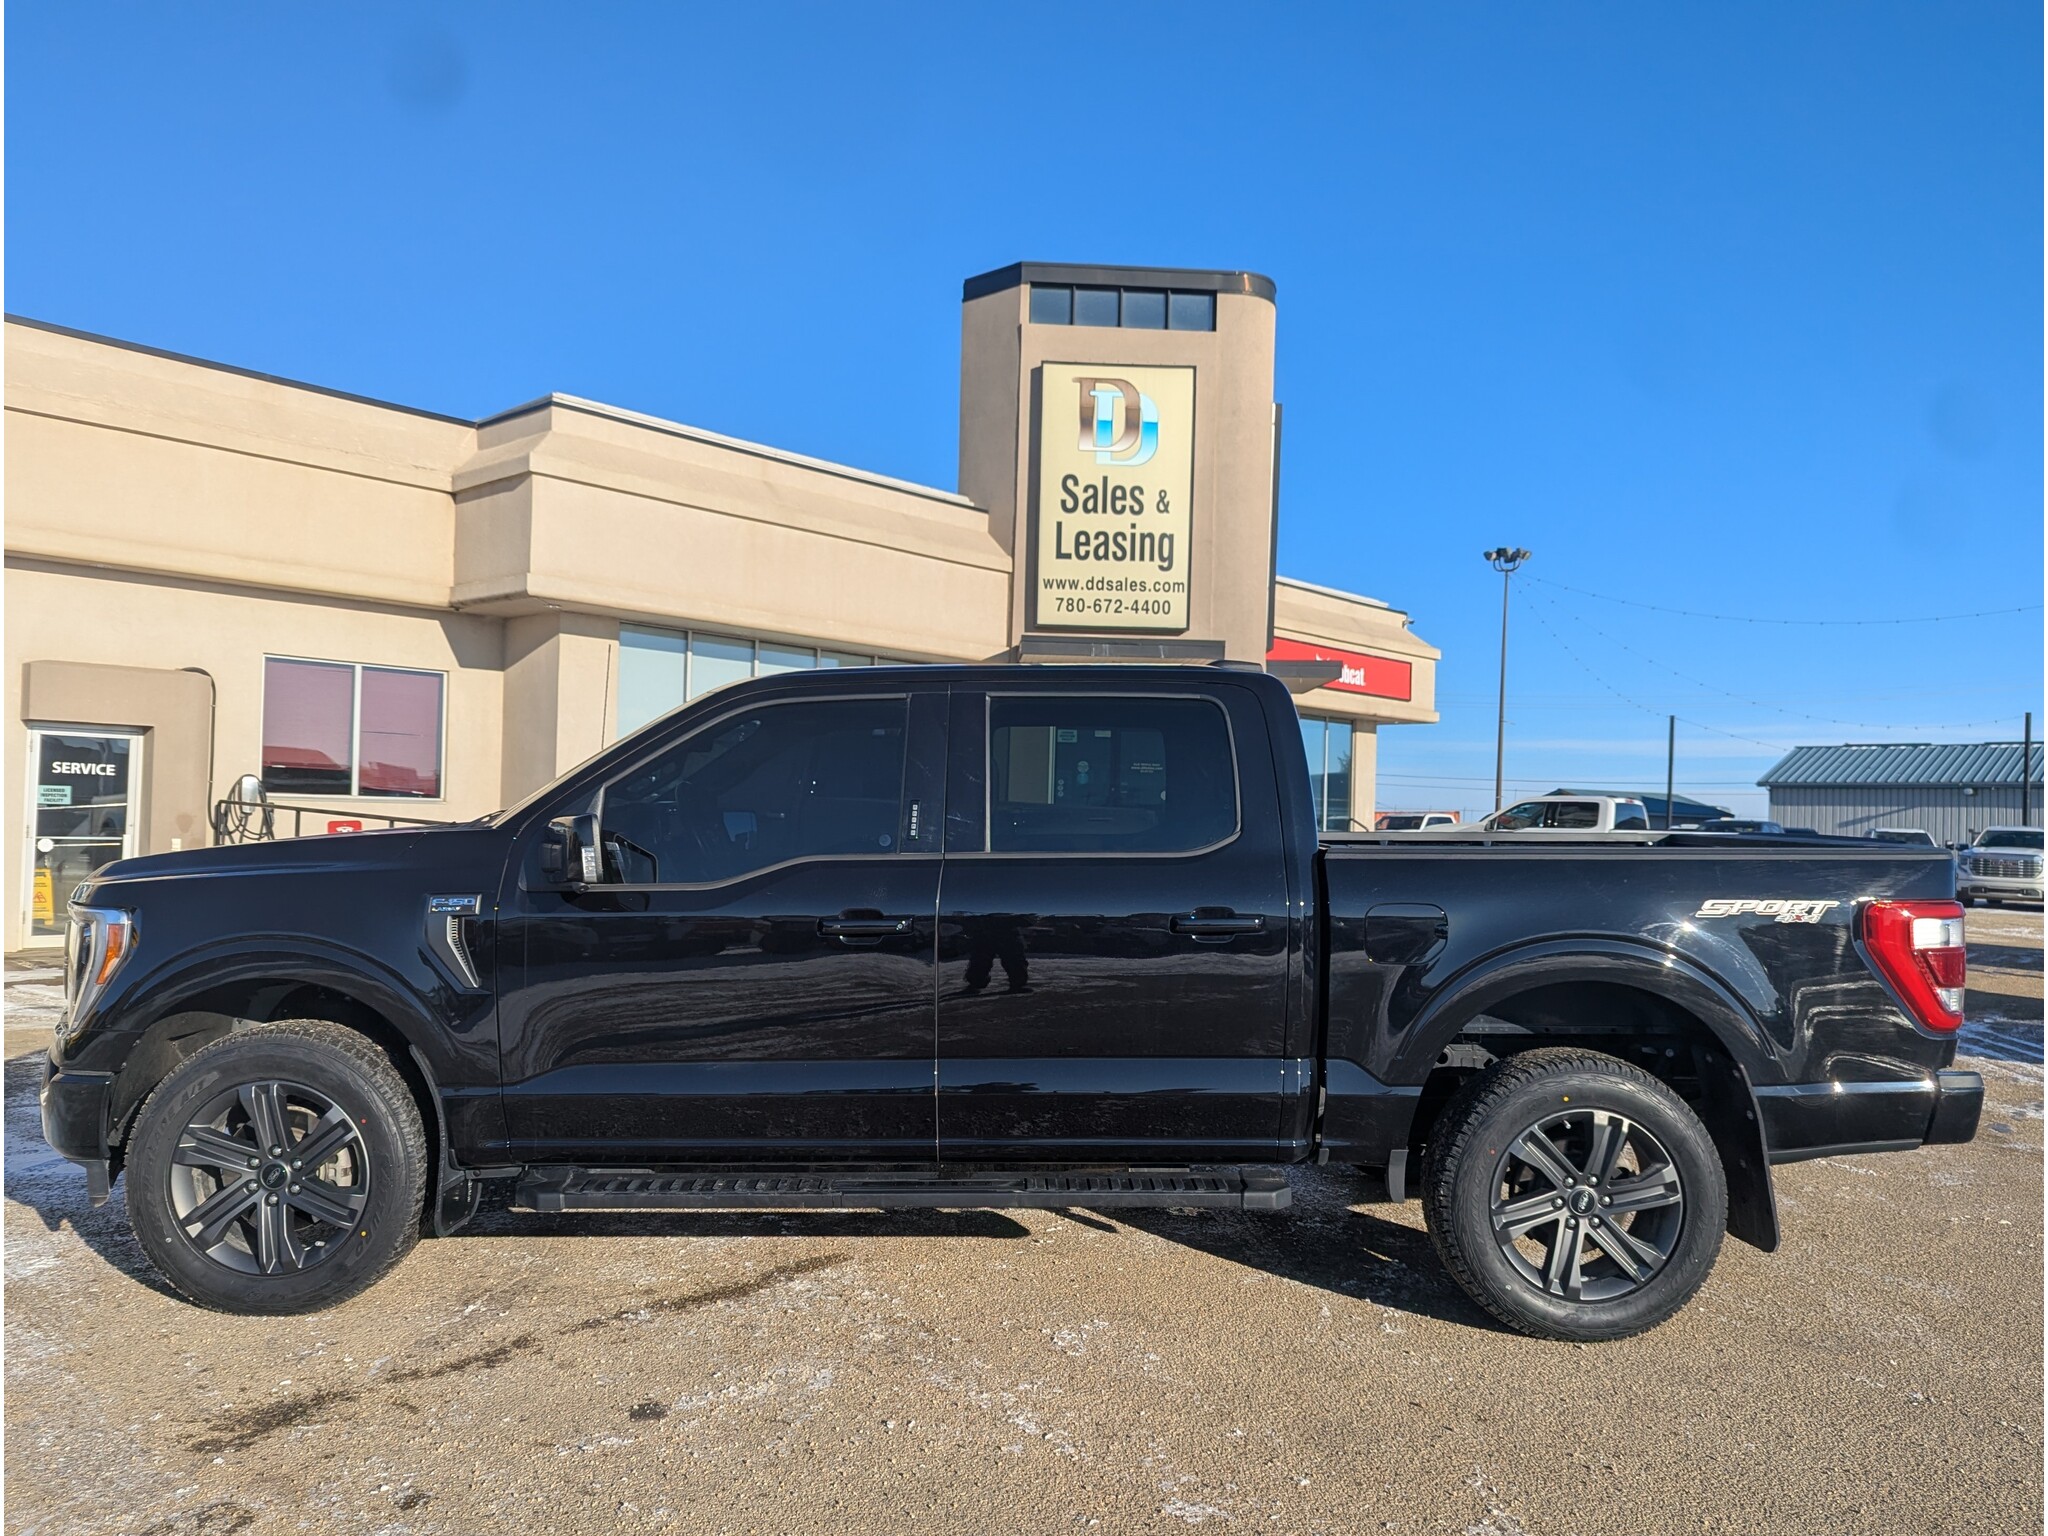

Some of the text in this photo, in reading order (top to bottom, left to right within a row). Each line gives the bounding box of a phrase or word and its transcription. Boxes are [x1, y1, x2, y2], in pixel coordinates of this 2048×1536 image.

[1060, 473, 1170, 516] Sales &
[1055, 521, 1175, 572] Leasing
[1043, 577, 1185, 593] www.ddsales.com
[1055, 598, 1171, 615] 780-672-4400
[52, 761, 116, 776] SERVICE
[1695, 899, 1840, 918] SPORT
